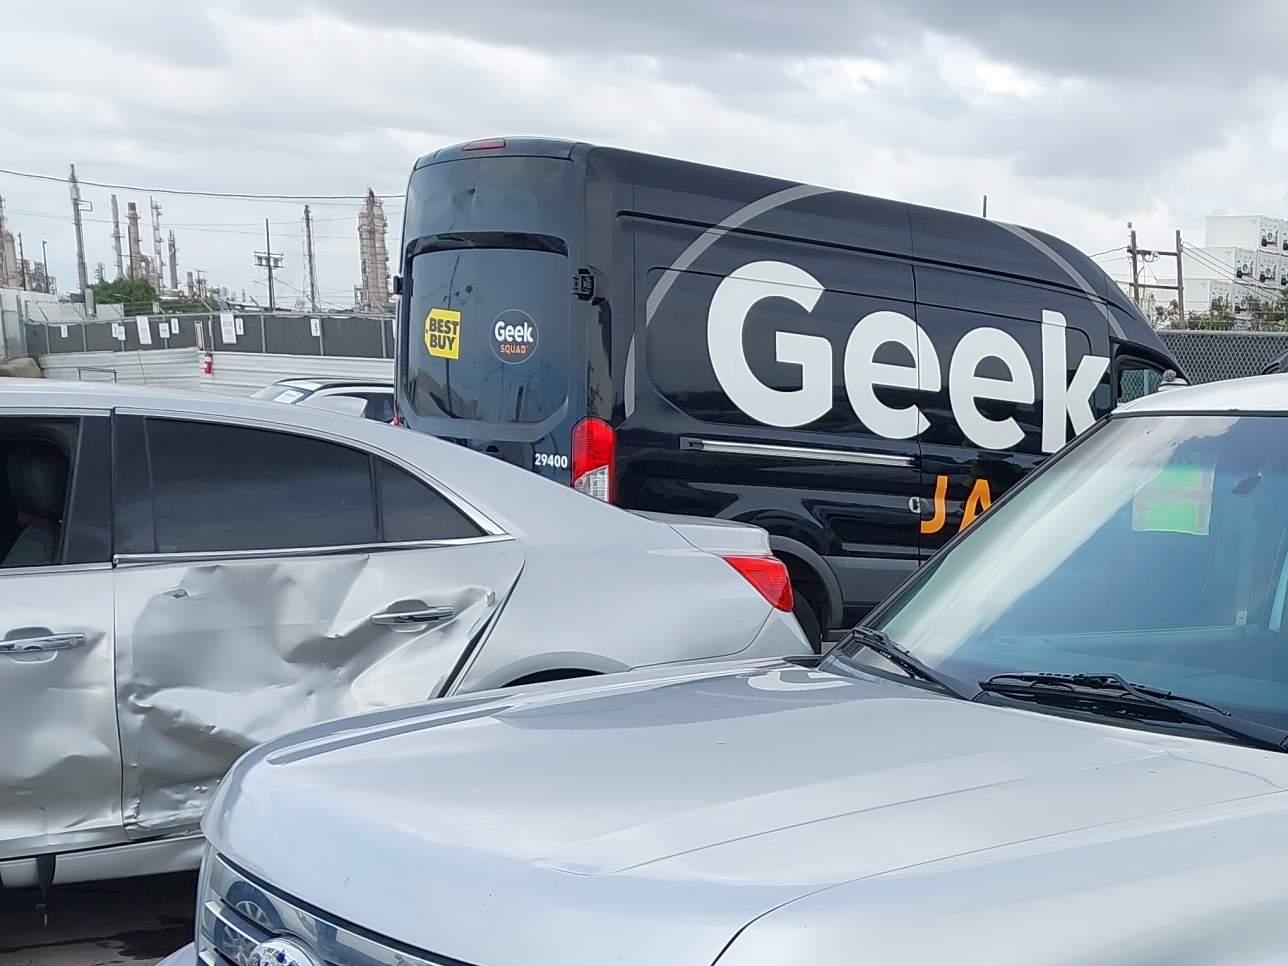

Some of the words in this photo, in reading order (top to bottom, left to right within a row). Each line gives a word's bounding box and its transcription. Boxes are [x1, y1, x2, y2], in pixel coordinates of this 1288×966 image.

[429, 317, 460, 336] BEST
[494, 320, 534, 343] Geek
[429, 333, 457, 351] BUY
[500, 343, 528, 355] SQUAD
[707, 261, 1111, 454] Geek
[534, 453, 568, 468] 29400
